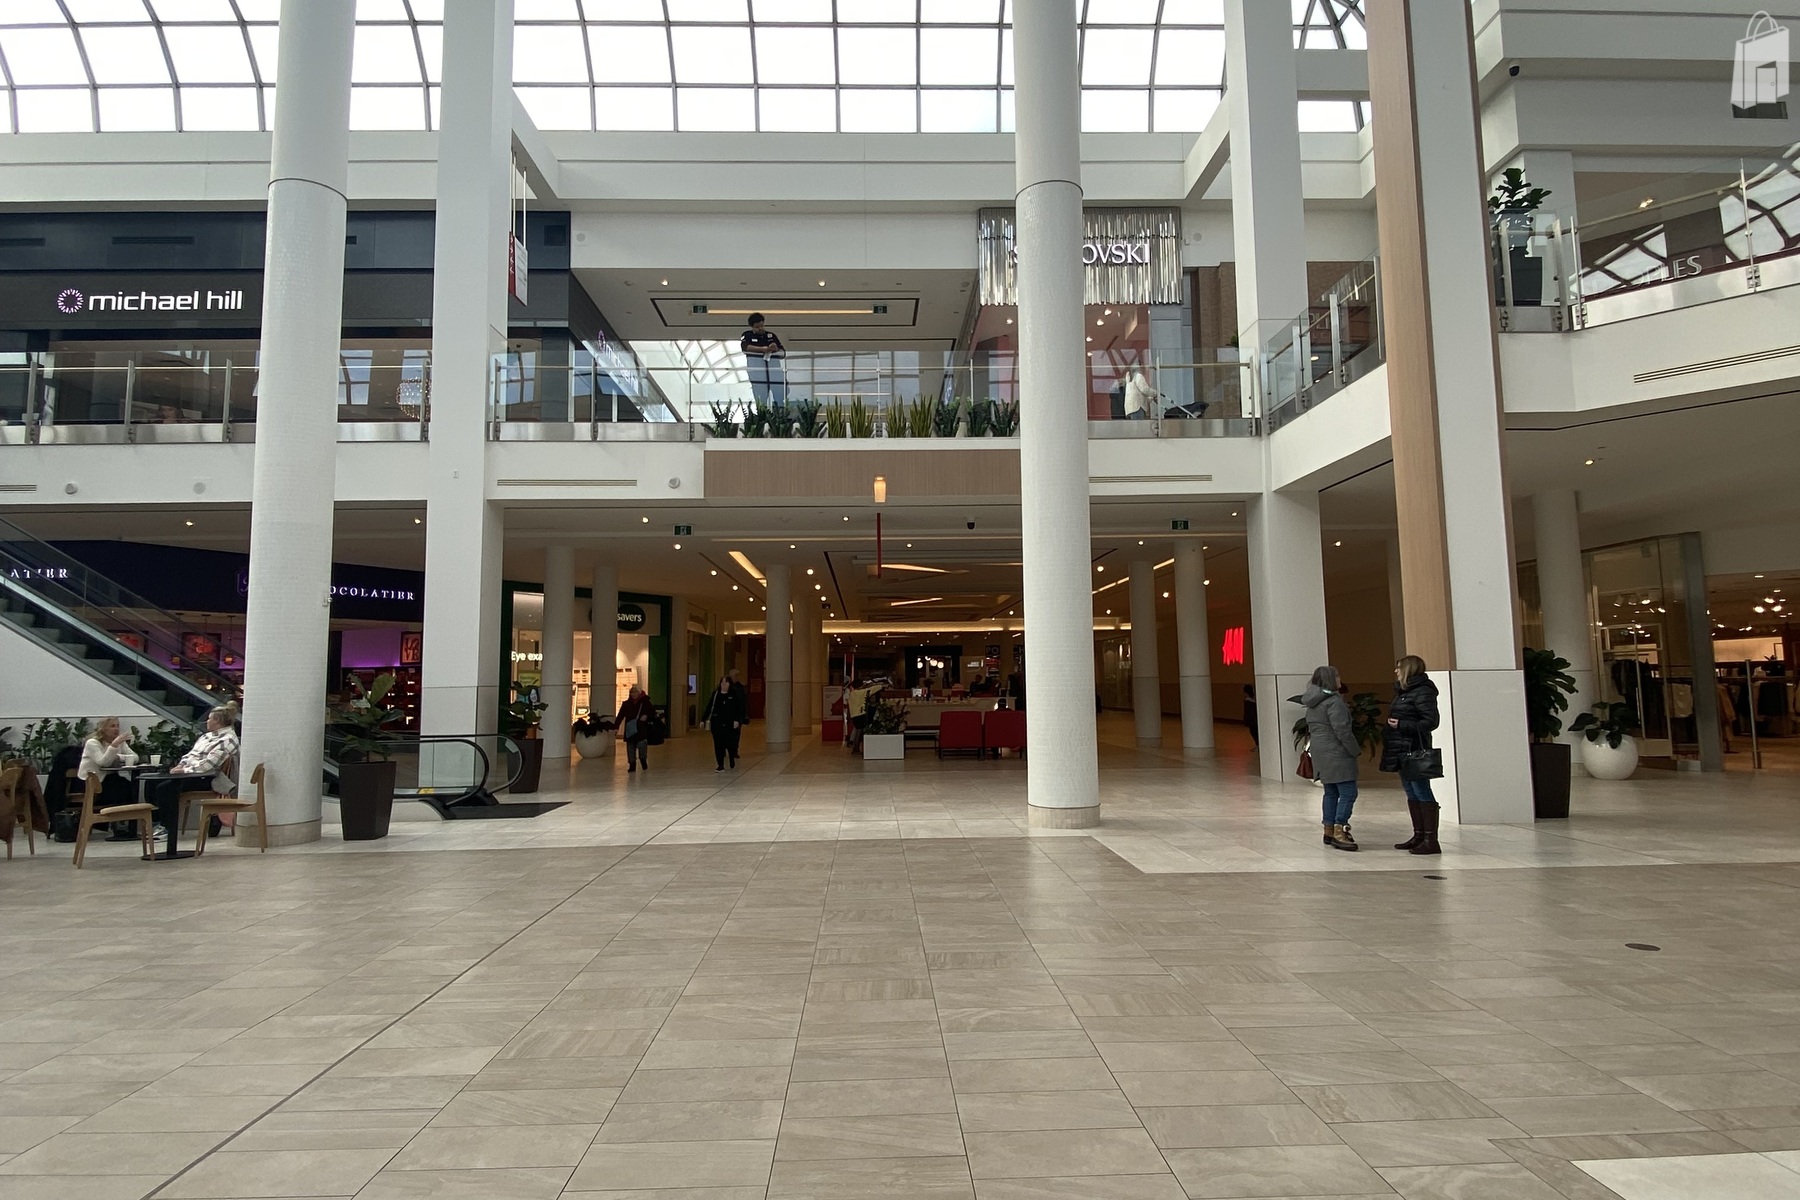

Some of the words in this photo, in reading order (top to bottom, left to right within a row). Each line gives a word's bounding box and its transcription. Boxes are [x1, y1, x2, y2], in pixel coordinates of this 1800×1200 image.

[88, 291, 199, 311] michael
[206, 291, 243, 310] hill
[0, 568, 69, 579] ATIER
[329, 585, 415, 601] OCOLATIER
[617, 613, 642, 622] savers
[511, 650, 527, 663] Eye
[527, 653, 543, 661] exa
